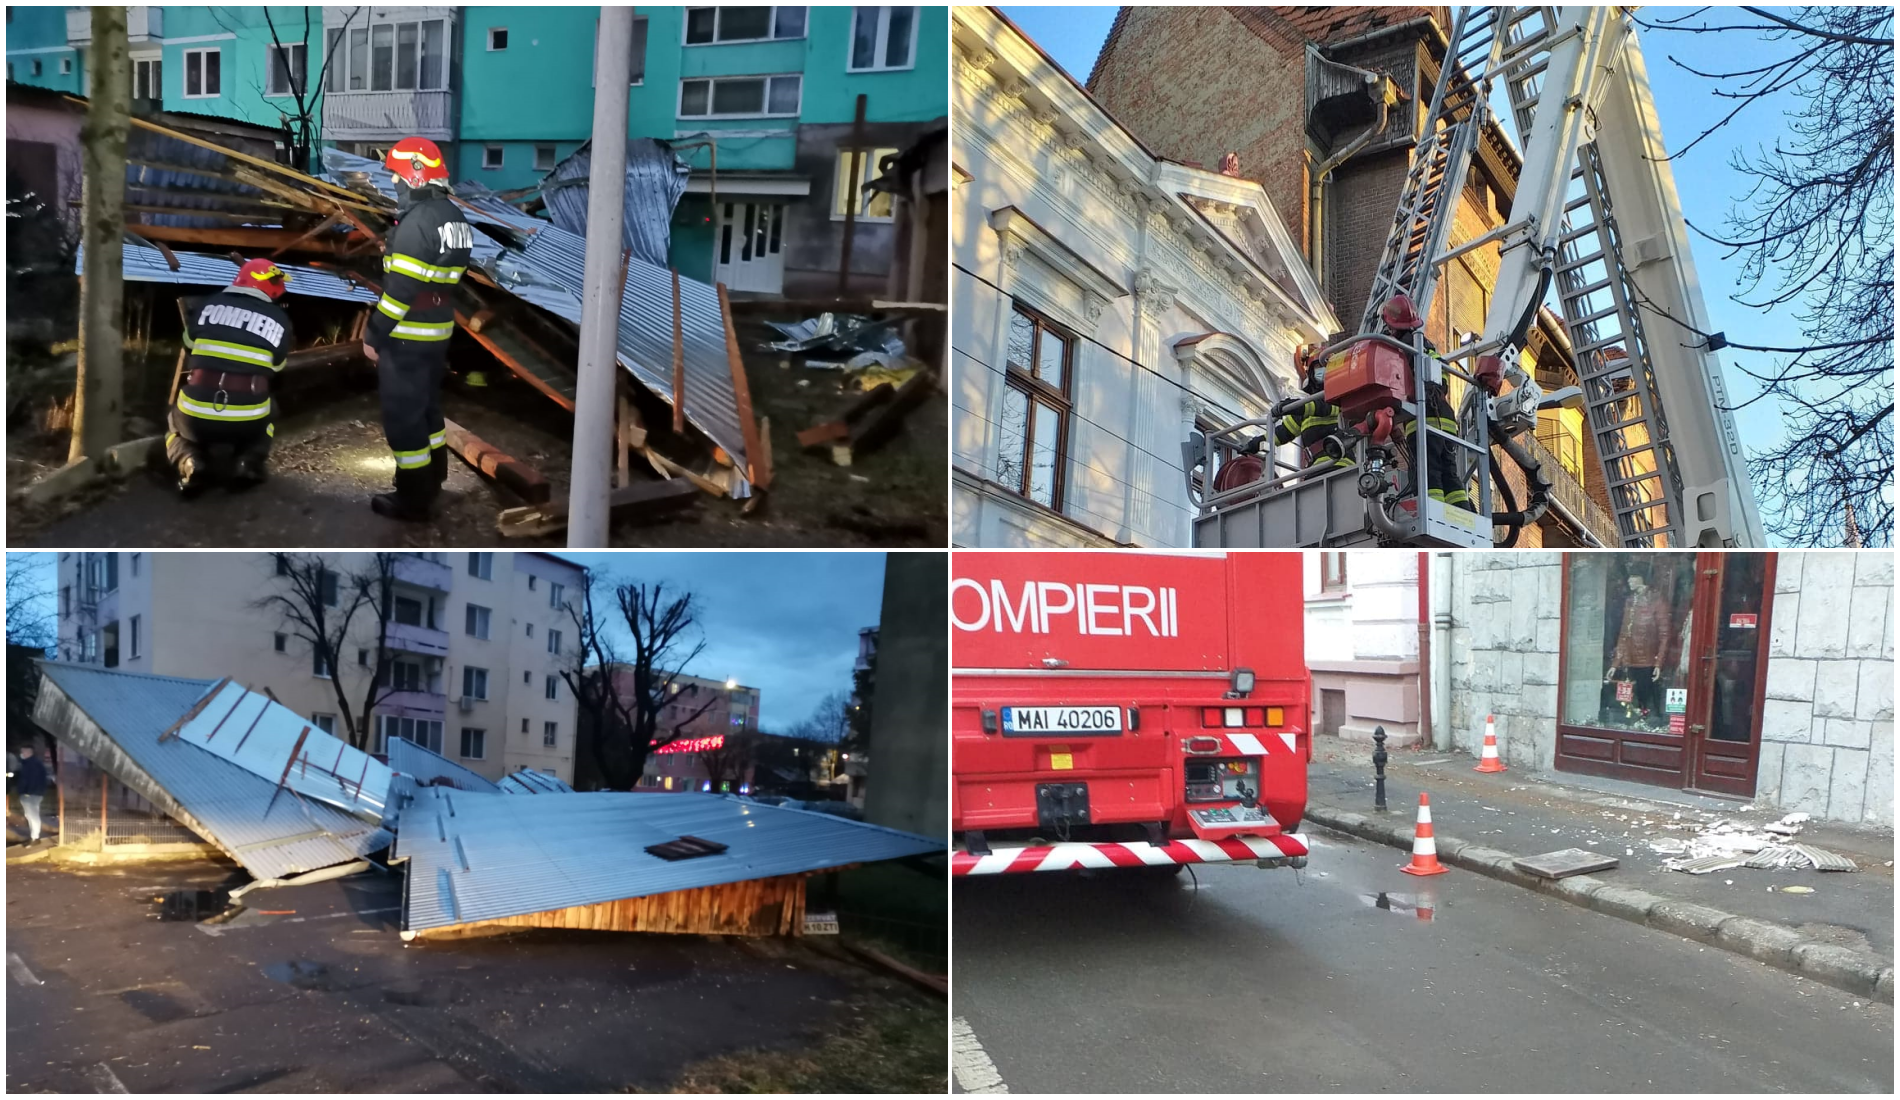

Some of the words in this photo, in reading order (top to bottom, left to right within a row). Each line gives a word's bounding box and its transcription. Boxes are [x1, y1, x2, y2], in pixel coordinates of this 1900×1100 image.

[951, 577, 1178, 637] OMPIERII
[1018, 710, 1048, 729] MAI
[1057, 710, 1115, 729] 40206
